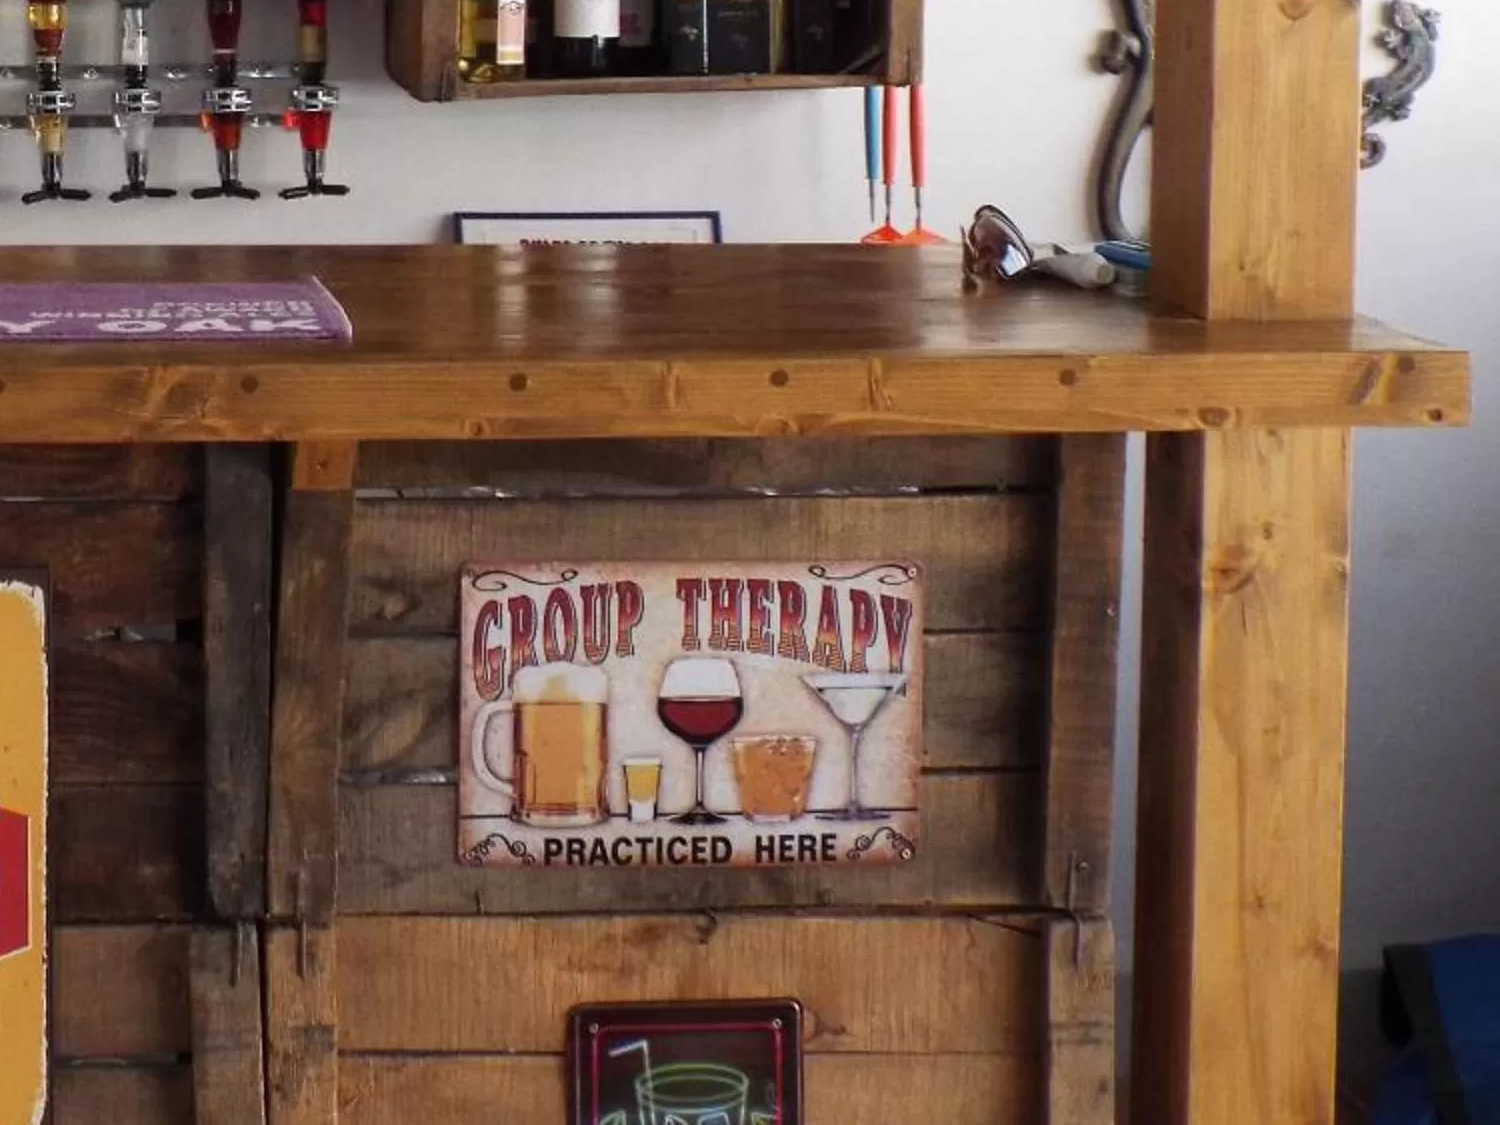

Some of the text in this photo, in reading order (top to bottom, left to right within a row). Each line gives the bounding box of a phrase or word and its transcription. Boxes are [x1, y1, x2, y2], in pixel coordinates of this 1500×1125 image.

[97, 317, 322, 333] OAK
[471, 577, 914, 701] GROUP THERAPY
[543, 832, 838, 868] PRACTICED HERE
